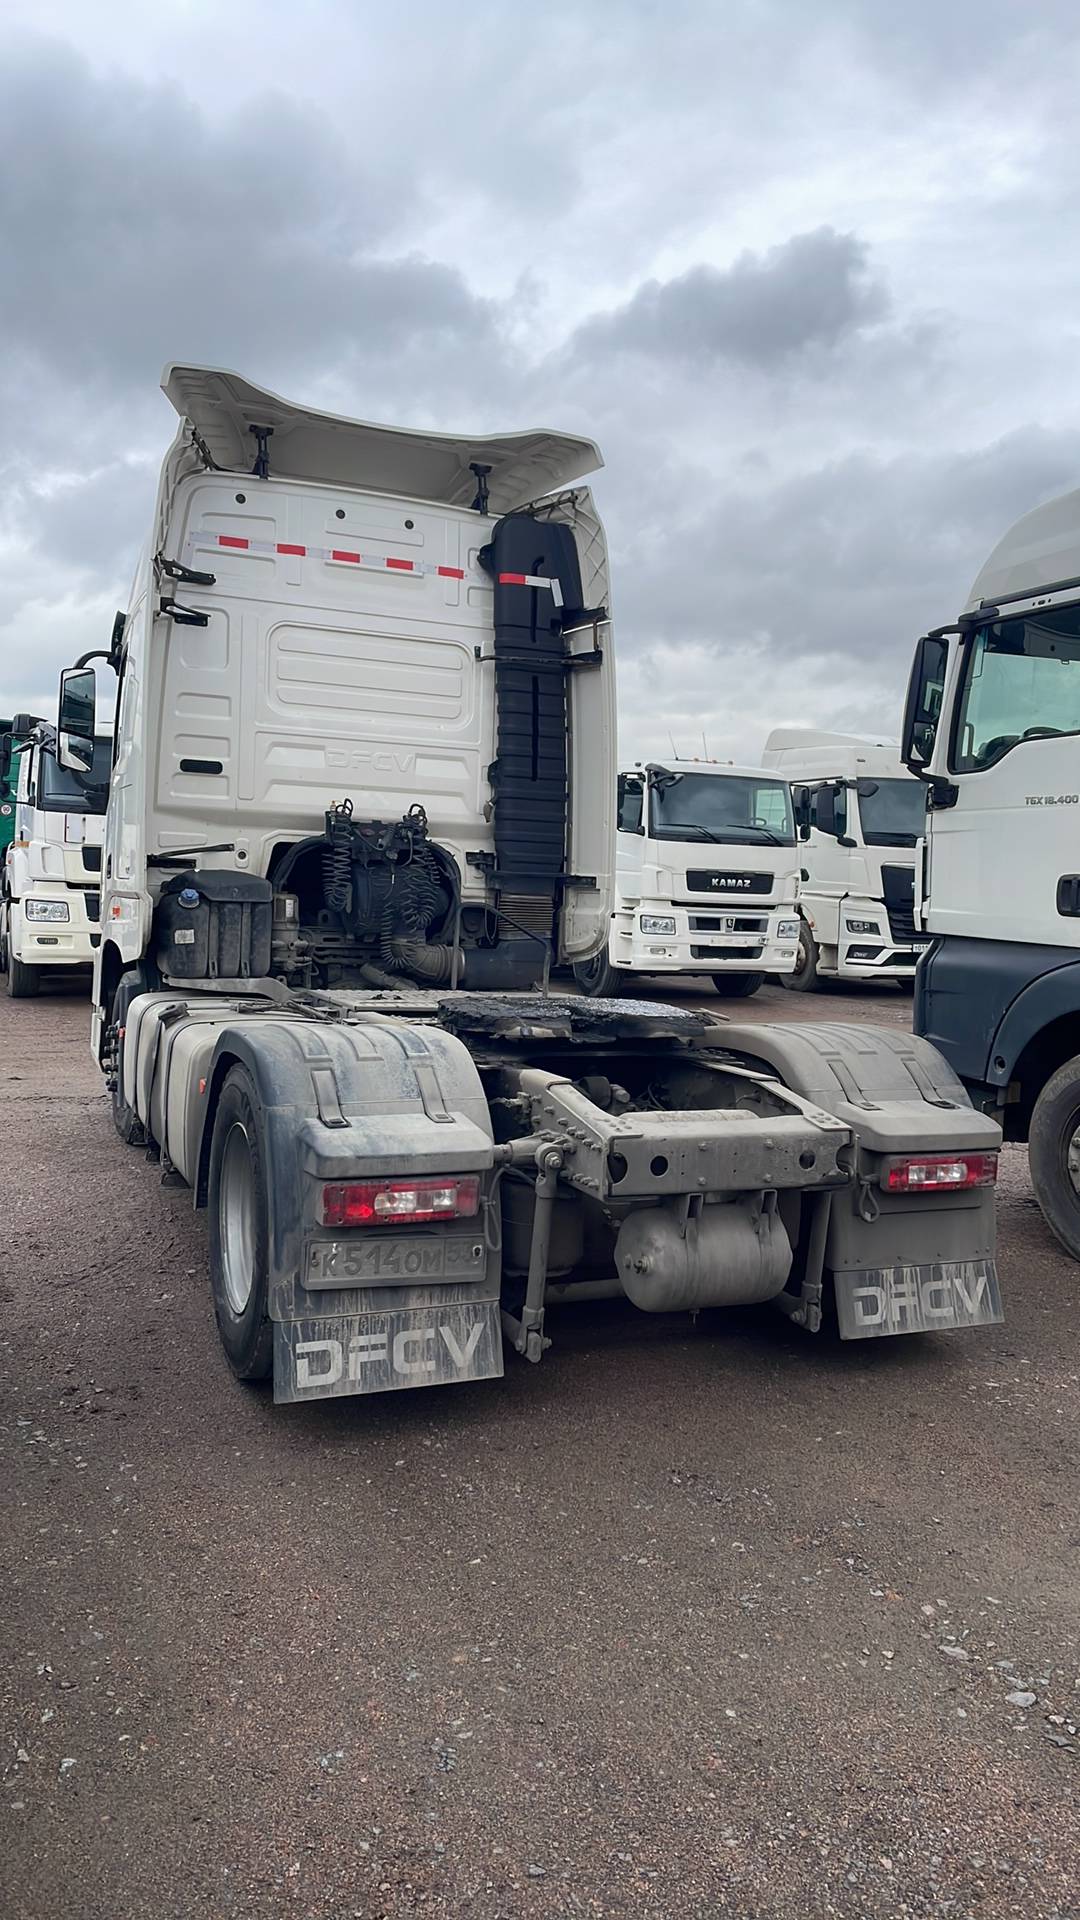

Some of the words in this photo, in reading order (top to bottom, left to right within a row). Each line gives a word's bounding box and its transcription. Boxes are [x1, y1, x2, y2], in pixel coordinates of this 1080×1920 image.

[325, 749, 415, 774] DFCV
[1044, 794, 1079, 805] 18.400
[711, 878, 752, 888] KAMAZ
[296, 1322, 486, 1389] DFCV
